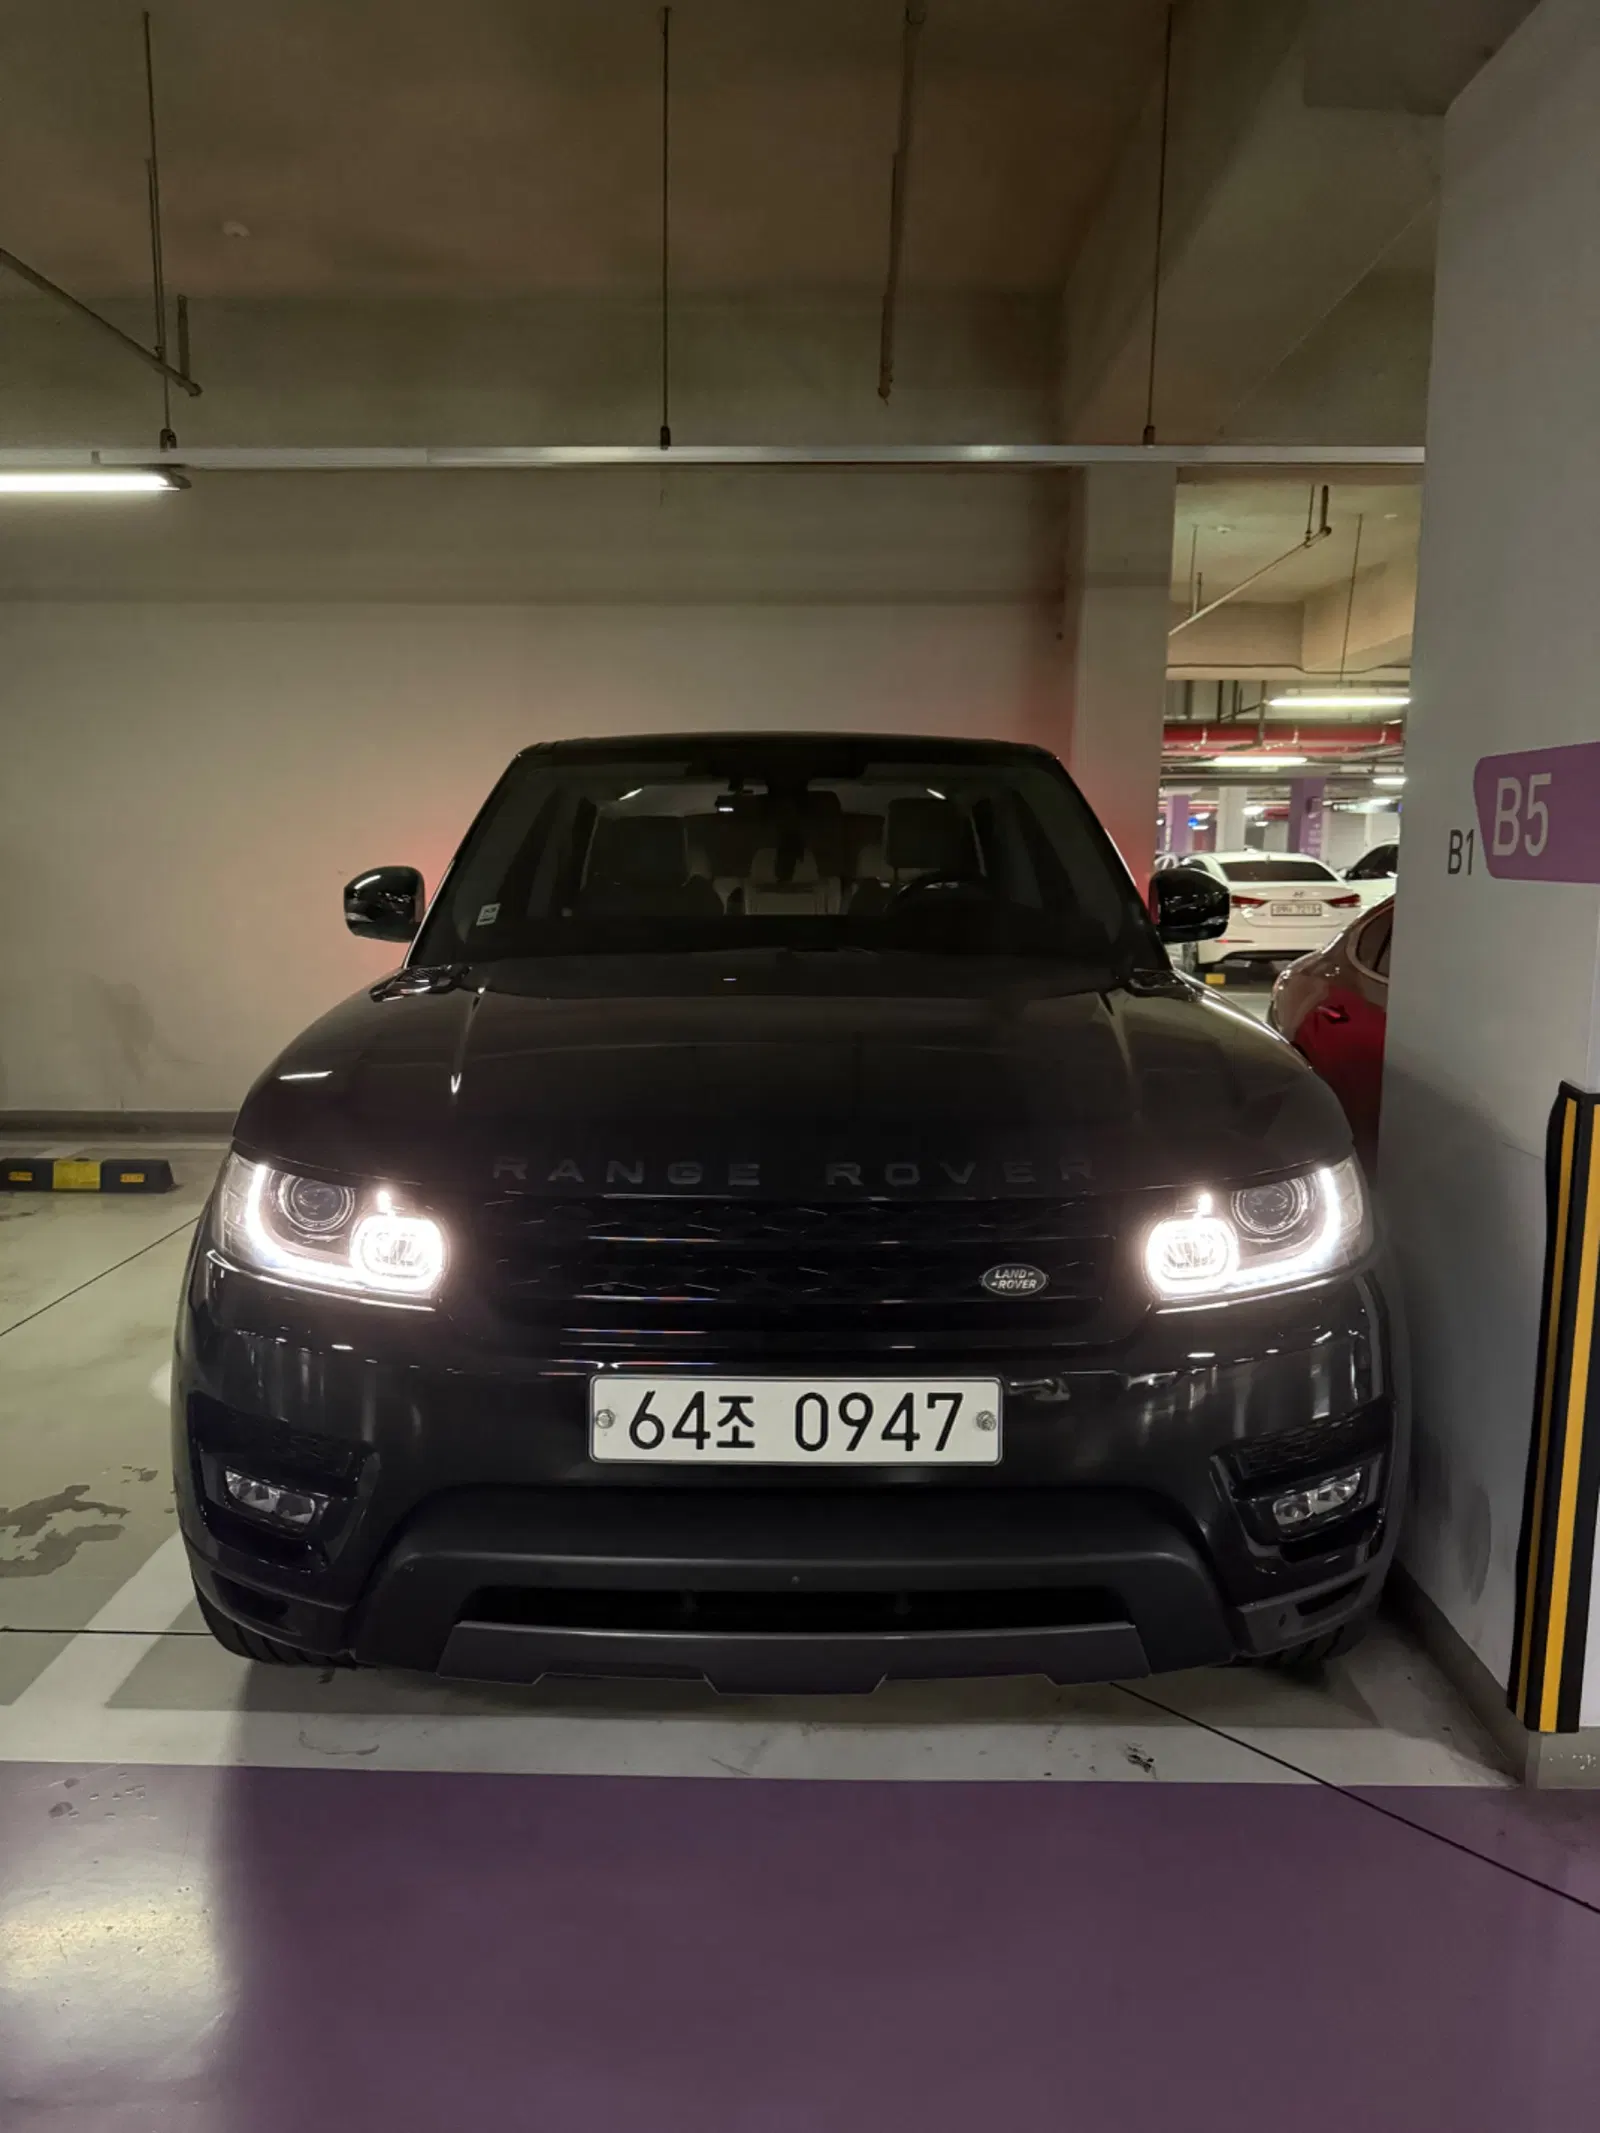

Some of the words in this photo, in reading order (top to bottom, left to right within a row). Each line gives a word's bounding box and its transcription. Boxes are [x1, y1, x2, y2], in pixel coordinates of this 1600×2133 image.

[1492, 772, 1552, 857] B5
[1447, 829, 1474, 876] B1
[492, 1156, 761, 1186] RANGE
[825, 1155, 1096, 1186] ROVER
[629, 1390, 755, 1450] 64조
[795, 1391, 964, 1452] 0947
